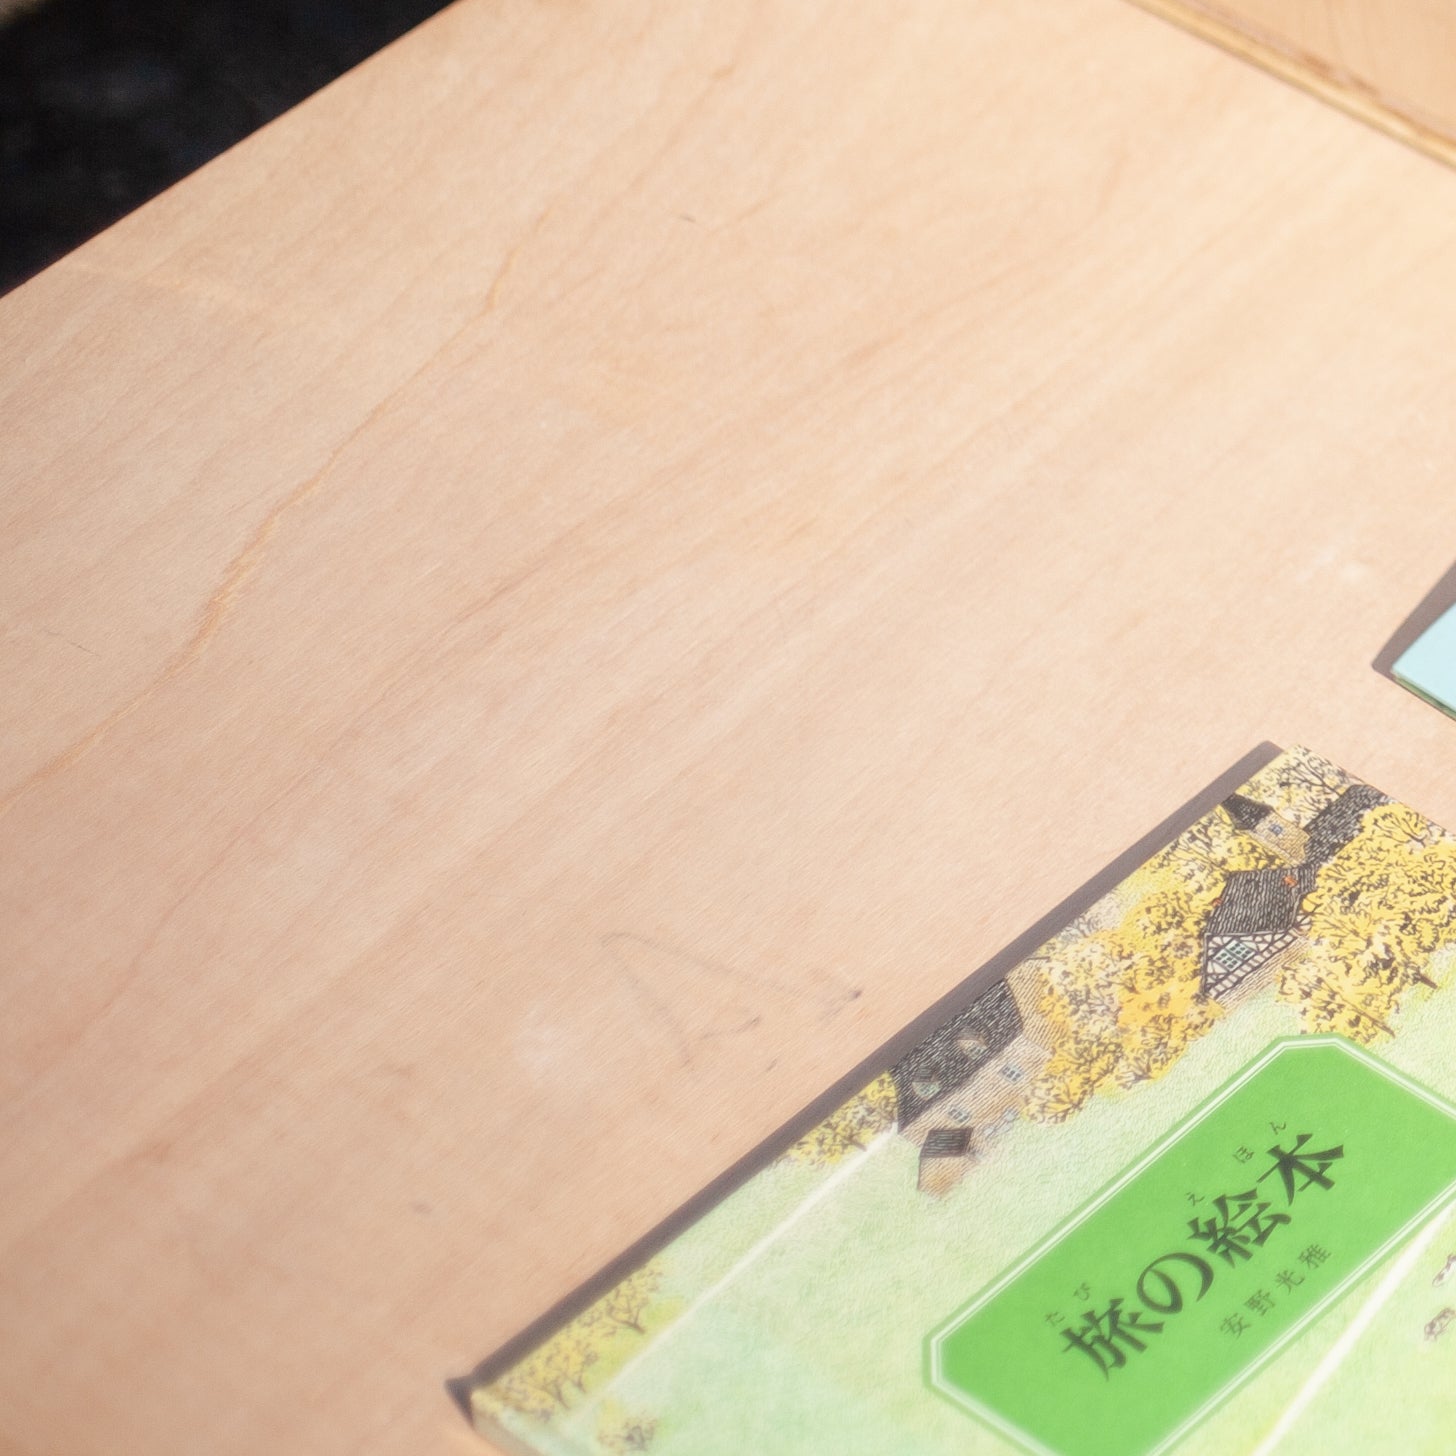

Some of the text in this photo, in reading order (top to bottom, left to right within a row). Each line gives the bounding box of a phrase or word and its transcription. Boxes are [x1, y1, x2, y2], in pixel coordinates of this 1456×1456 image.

[1044, 1282, 1092, 1328] たび
[1061, 1132, 1345, 1383] 旅の絵本
[1218, 1243, 1333, 1340] 安野光雅
